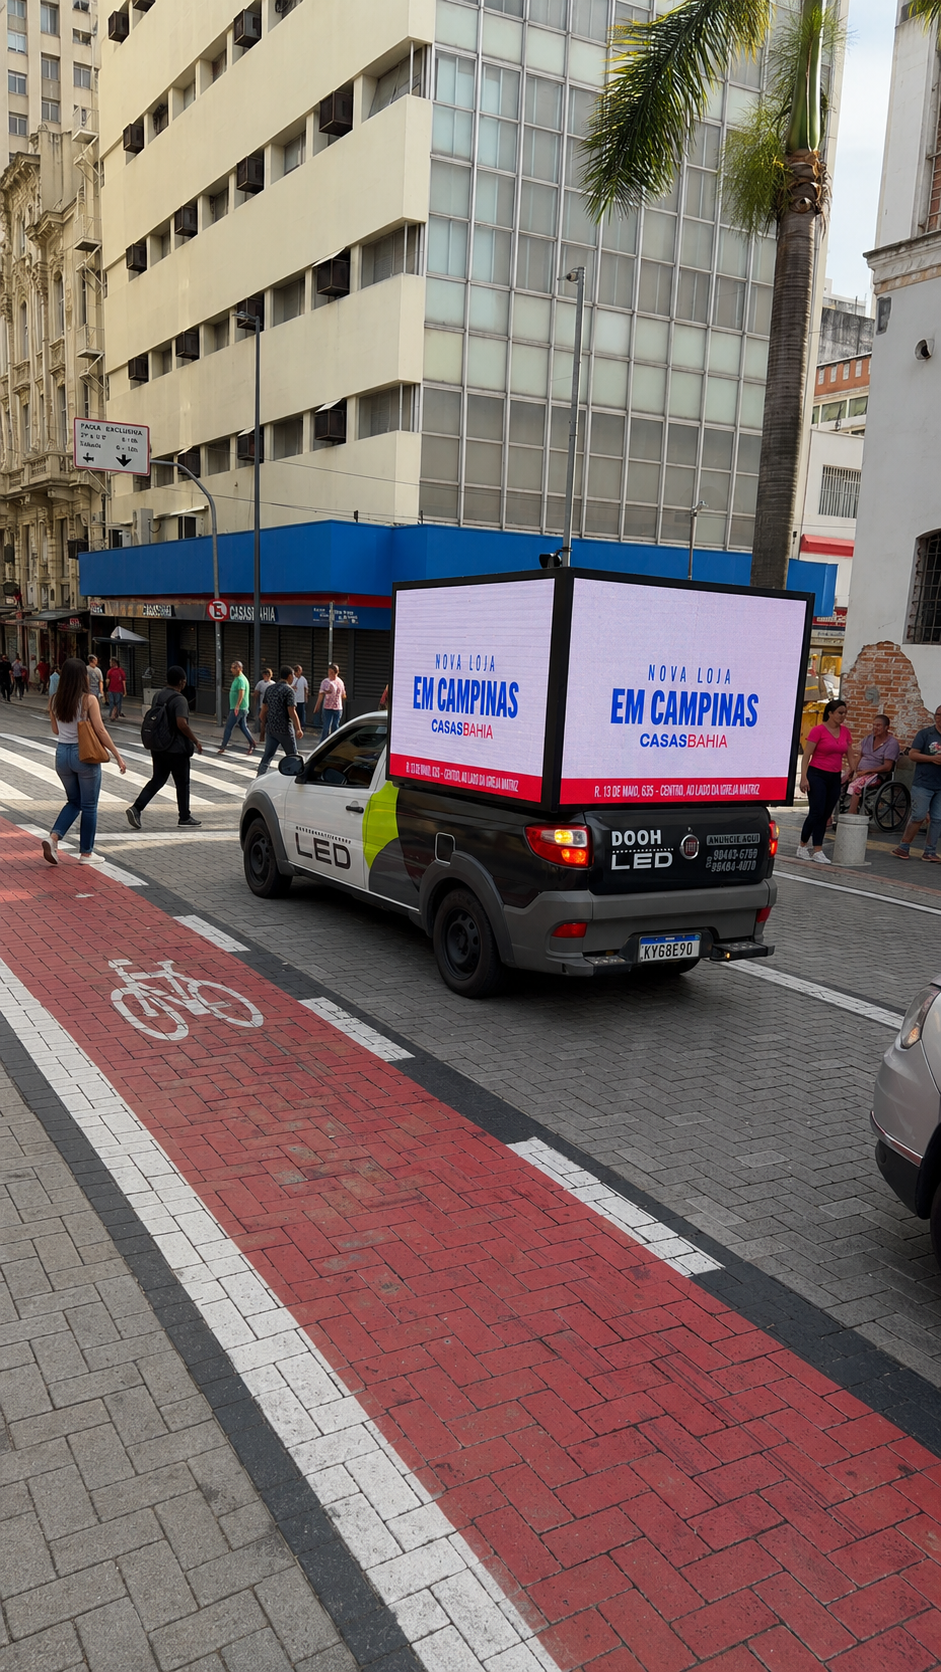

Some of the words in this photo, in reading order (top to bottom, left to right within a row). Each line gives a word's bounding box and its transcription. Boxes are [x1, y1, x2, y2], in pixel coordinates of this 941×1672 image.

[229, 606, 276, 621] CASASAHIA
[435, 653, 461, 670] NOVA
[469, 654, 495, 672] LOJA
[648, 664, 686, 682] NOVA
[697, 667, 731, 684] LOJA
[413, 675, 435, 711] EM
[437, 677, 520, 719] CAMPINAS
[610, 688, 645, 725] EM
[650, 690, 759, 728] CAMPINAS
[431, 718, 493, 739] CASASBAHIA
[639, 733, 728, 748] CASASBAHIA
[594, 785, 602, 798] R.
[603, 785, 611, 798] 13
[612, 785, 621, 798] DE
[711, 784, 719, 796] DA
[611, 829, 662, 847] DOOH
[295, 832, 351, 870] LED
[611, 852, 673, 870] LED
